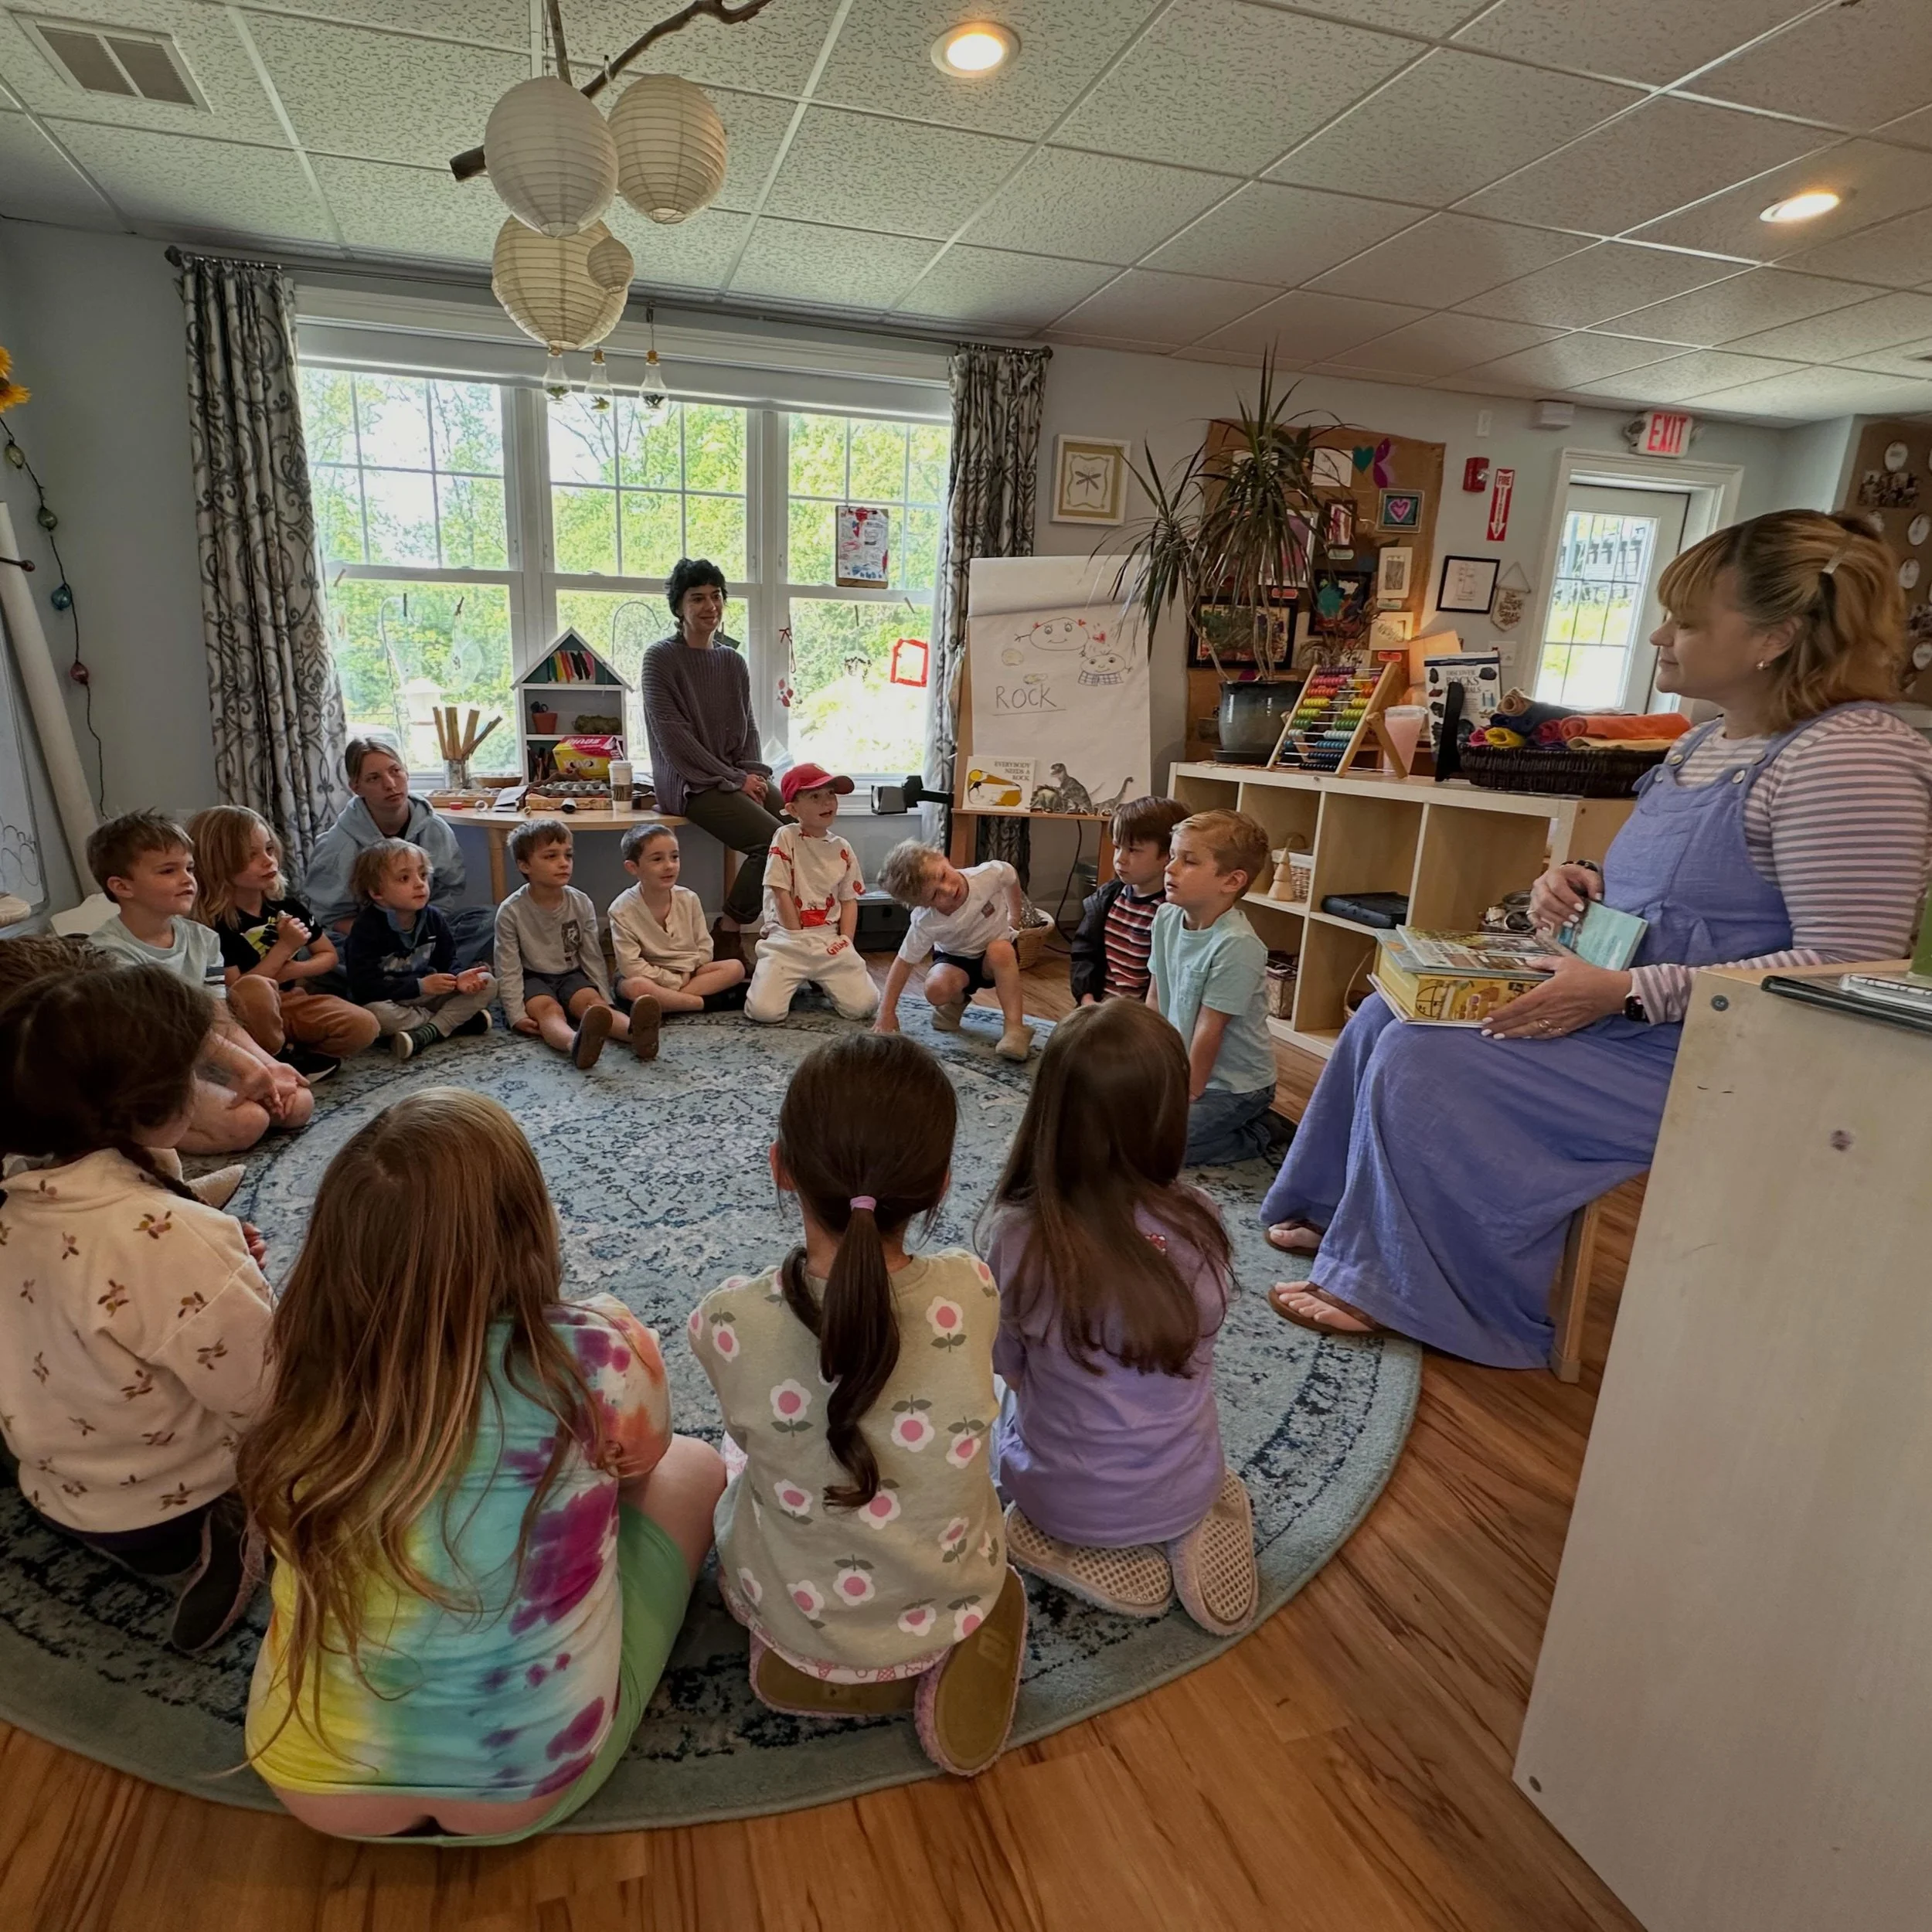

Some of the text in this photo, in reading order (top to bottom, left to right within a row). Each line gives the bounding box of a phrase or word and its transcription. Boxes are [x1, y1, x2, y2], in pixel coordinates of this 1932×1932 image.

[1647, 413, 1688, 454] EXIT
[1498, 475, 1512, 486] FIRE
[995, 683, 1057, 709] ROCK
